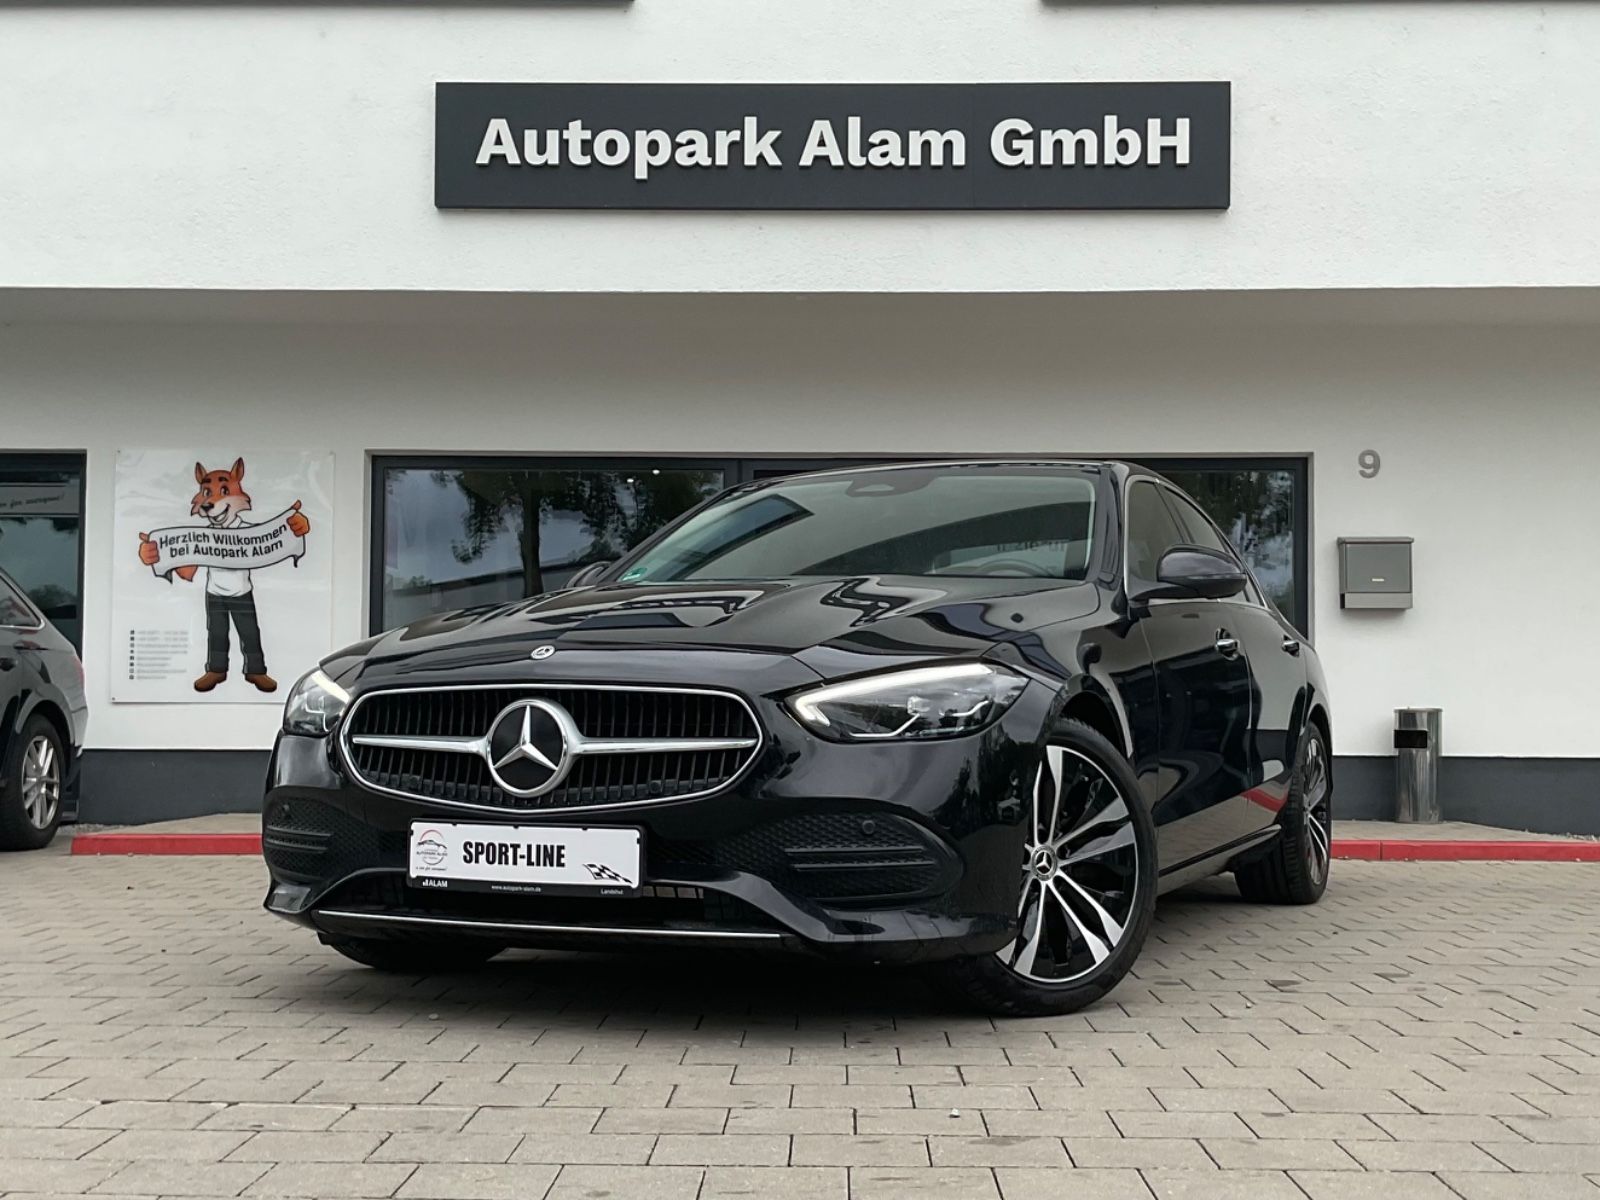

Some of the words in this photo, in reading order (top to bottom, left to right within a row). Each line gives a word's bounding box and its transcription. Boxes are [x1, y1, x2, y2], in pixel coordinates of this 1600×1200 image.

[475, 117, 782, 180] Autopark
[799, 115, 967, 169] Alam
[989, 115, 1192, 167] GmbH
[1358, 449, 1380, 479] 9
[159, 531, 210, 549] Herzlich
[212, 523, 287, 546] Willkommen
[169, 544, 190, 558] bei
[193, 544, 248, 558] Autopark
[252, 540, 283, 557] Alam
[463, 841, 565, 868] SPORT-LINE
